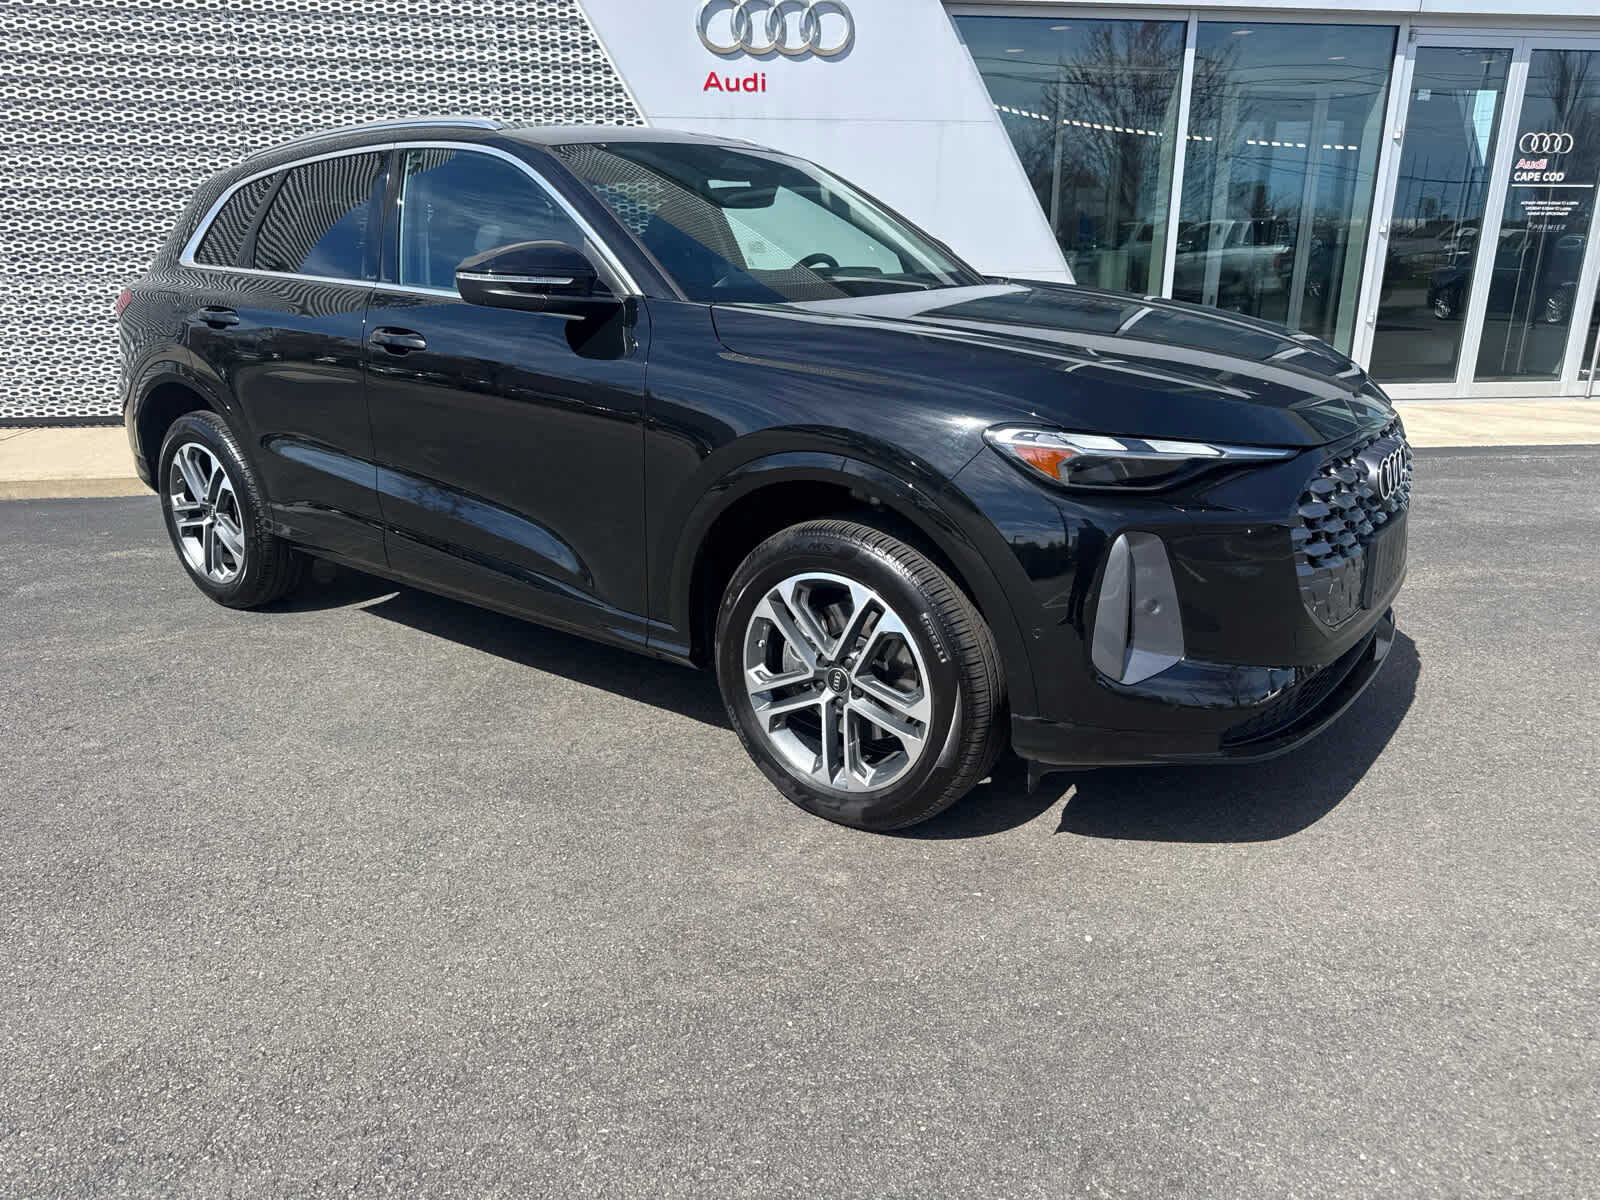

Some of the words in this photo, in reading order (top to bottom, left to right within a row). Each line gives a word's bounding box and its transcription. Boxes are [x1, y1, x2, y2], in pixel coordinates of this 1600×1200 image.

[703, 71, 766, 93] Audi
[1515, 158, 1548, 170] Audi
[1513, 172, 1541, 182] CAPE
[1542, 172, 1565, 182] COD
